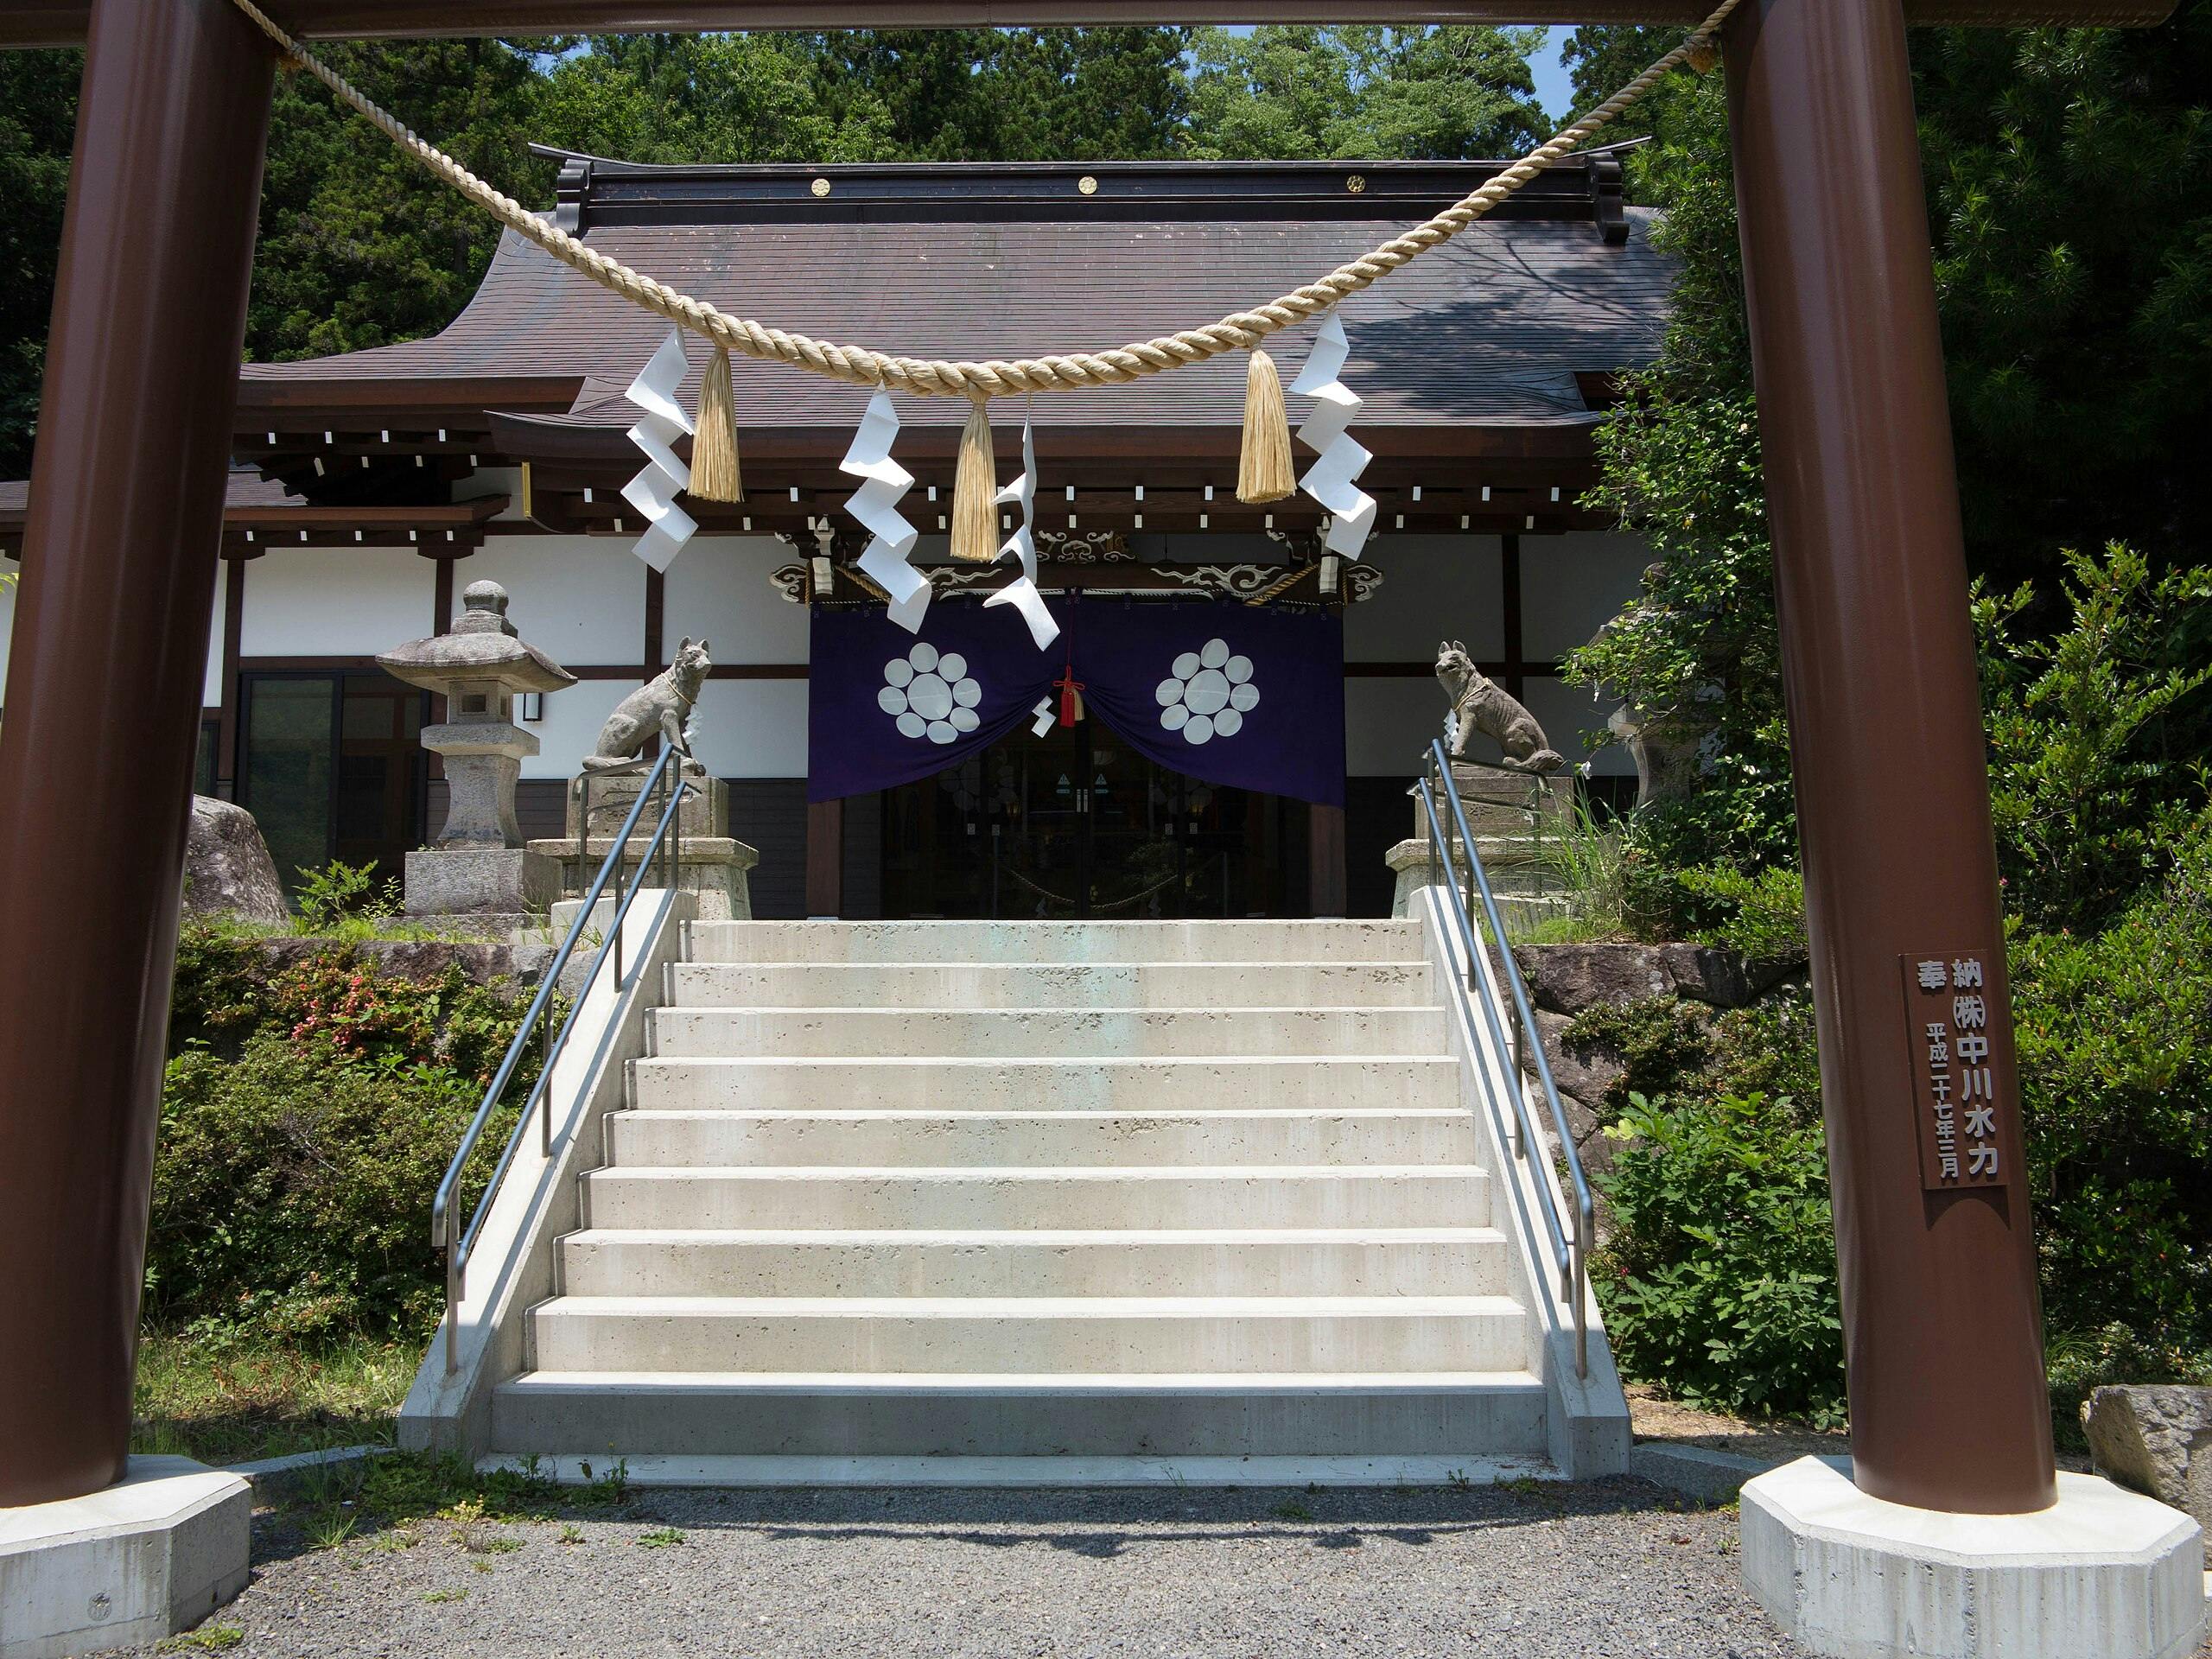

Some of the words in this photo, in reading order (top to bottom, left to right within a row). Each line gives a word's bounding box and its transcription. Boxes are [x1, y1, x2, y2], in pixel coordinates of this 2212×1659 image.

[1926, 1023, 1959, 1179] 平成二十七年三月
